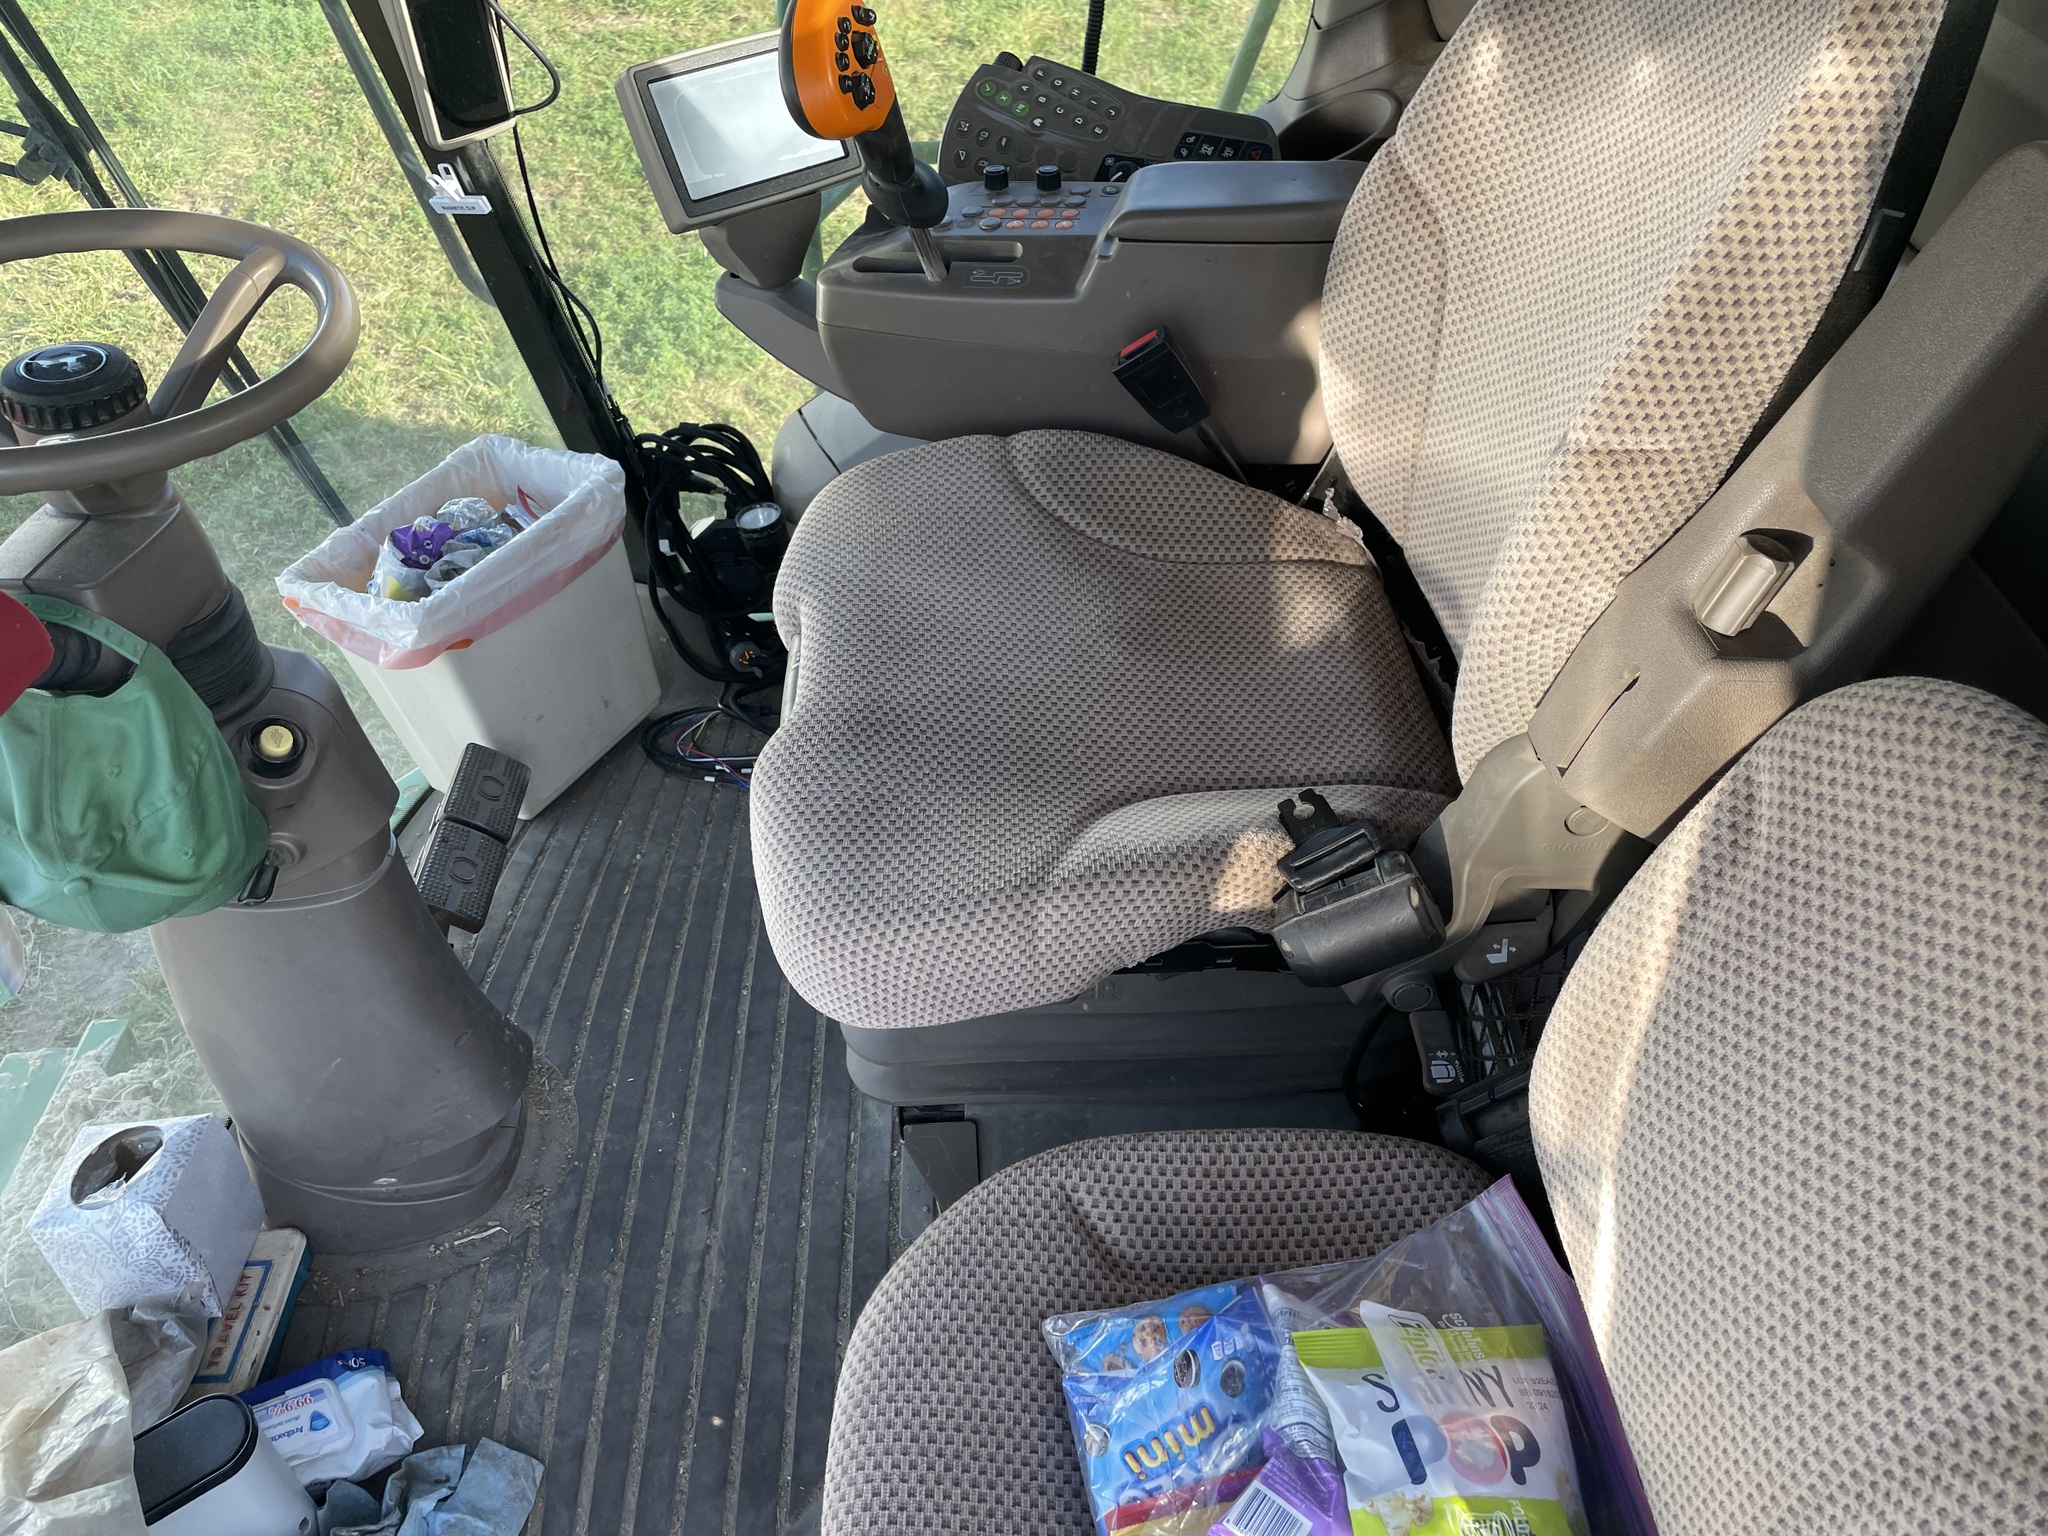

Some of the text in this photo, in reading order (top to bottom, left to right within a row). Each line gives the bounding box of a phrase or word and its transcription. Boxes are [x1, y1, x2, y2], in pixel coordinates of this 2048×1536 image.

[1075, 117, 1083, 125] D
[1095, 126, 1103, 134] E
[207, 1273, 252, 1369] TRAVEL KIT
[269, 1394, 314, 1417] 99.9%
[1124, 1406, 1216, 1480] mini
[1391, 1411, 1541, 1486] POP
